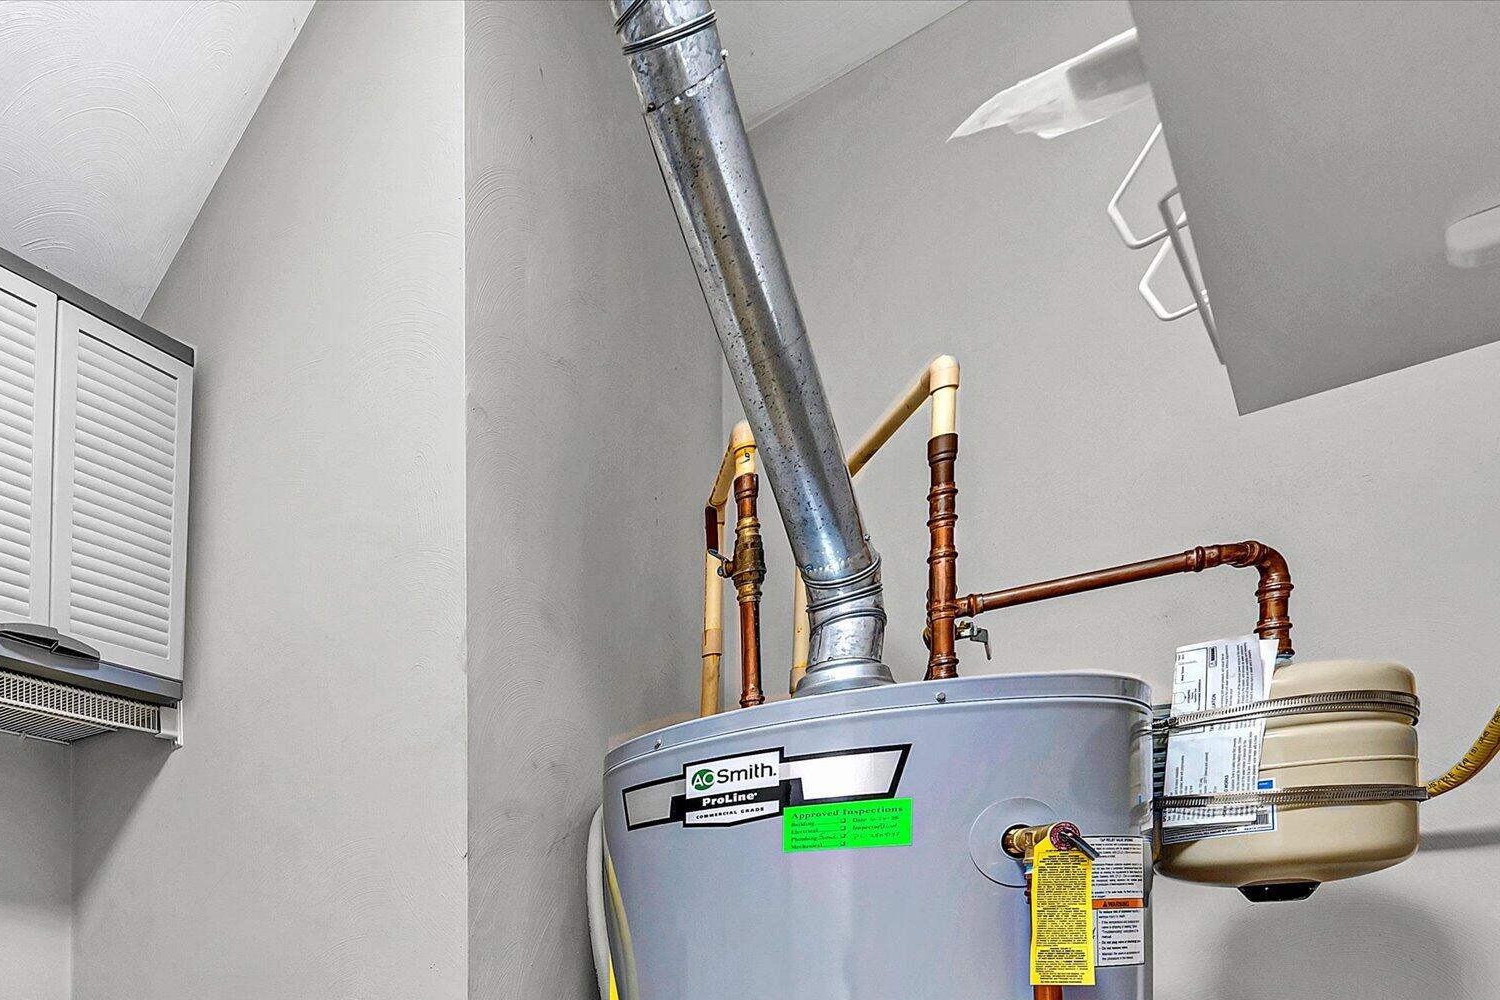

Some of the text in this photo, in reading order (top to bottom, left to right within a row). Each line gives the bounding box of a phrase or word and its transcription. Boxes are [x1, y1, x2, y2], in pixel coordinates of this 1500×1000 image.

[702, 793, 755, 806] ProLine
[696, 811, 737, 819] COMMERCIAL
[792, 806, 903, 819] Approved Inspections
